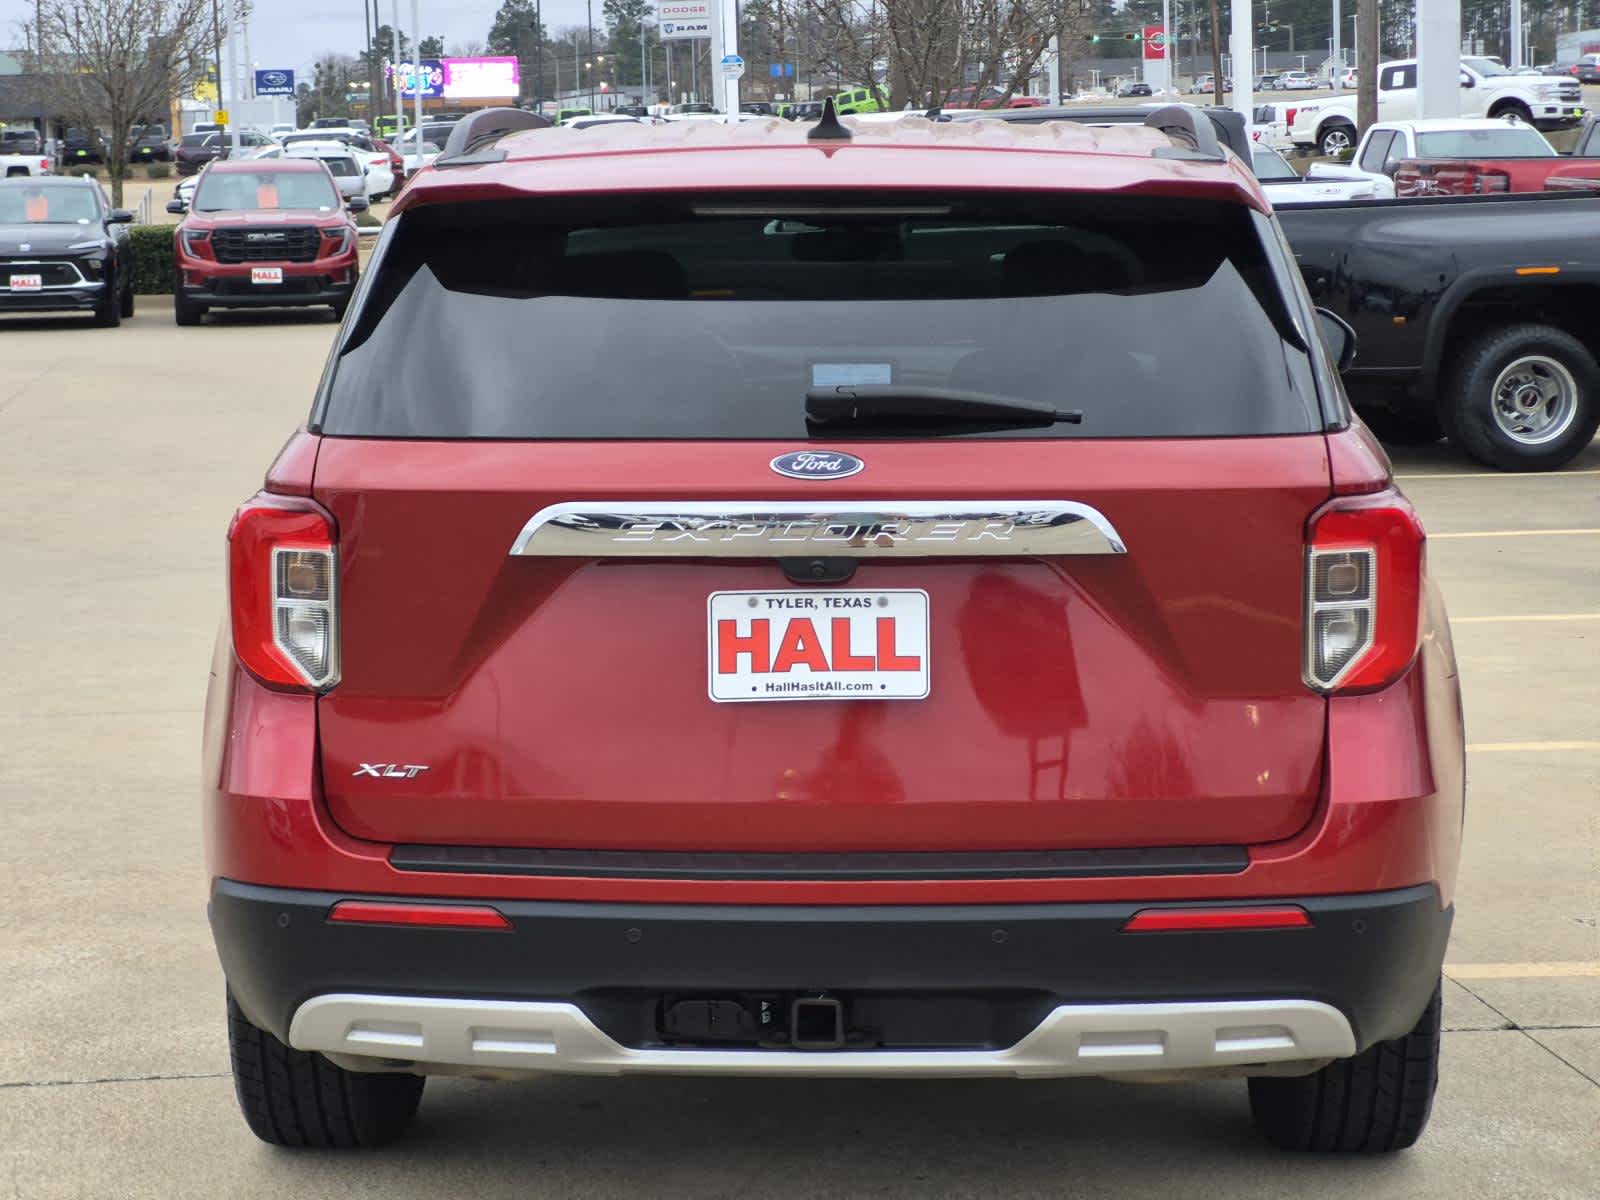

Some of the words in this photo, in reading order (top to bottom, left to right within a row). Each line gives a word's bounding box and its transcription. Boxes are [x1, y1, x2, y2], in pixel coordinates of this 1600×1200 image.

[663, 6, 705, 14] DODGE
[247, 233, 285, 241] GMC
[252, 271, 281, 280] HALL
[12, 279, 38, 287] HALL
[791, 453, 842, 471] Ford
[612, 520, 1015, 542] EXPLORER
[766, 598, 818, 610] TYLER,
[823, 597, 872, 608] TEXAS
[718, 616, 921, 674] HALL
[765, 681, 873, 692] HallHasItAll.com
[352, 763, 429, 778] XLT
